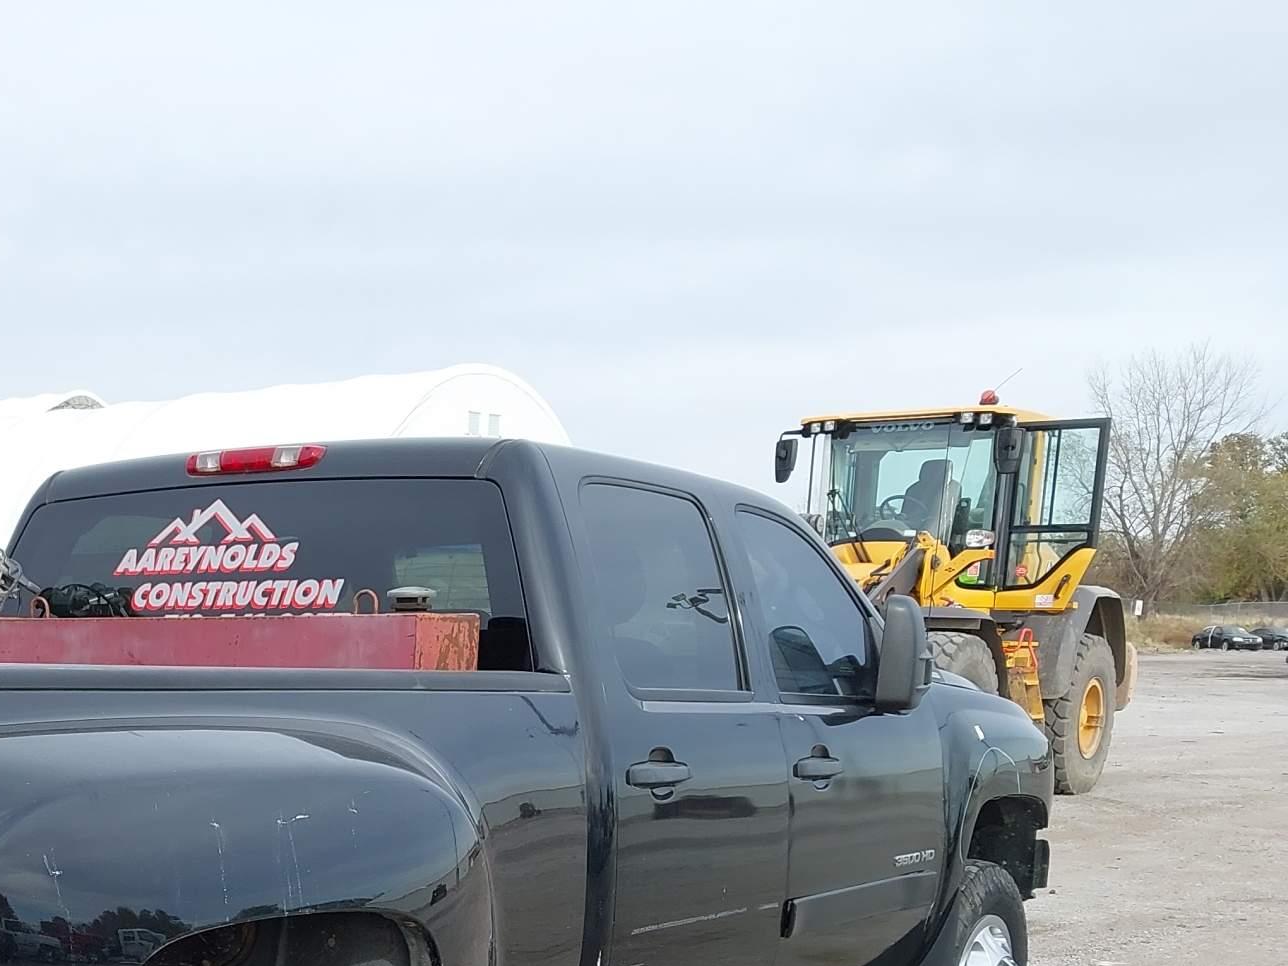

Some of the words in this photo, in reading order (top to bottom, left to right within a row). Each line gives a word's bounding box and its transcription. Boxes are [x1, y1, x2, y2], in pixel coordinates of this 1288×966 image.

[872, 421, 935, 433] VOLVO
[113, 542, 299, 576] AAREYNOLDS
[131, 578, 345, 611] CONSTRUCTION
[921, 849, 935, 862] HD
